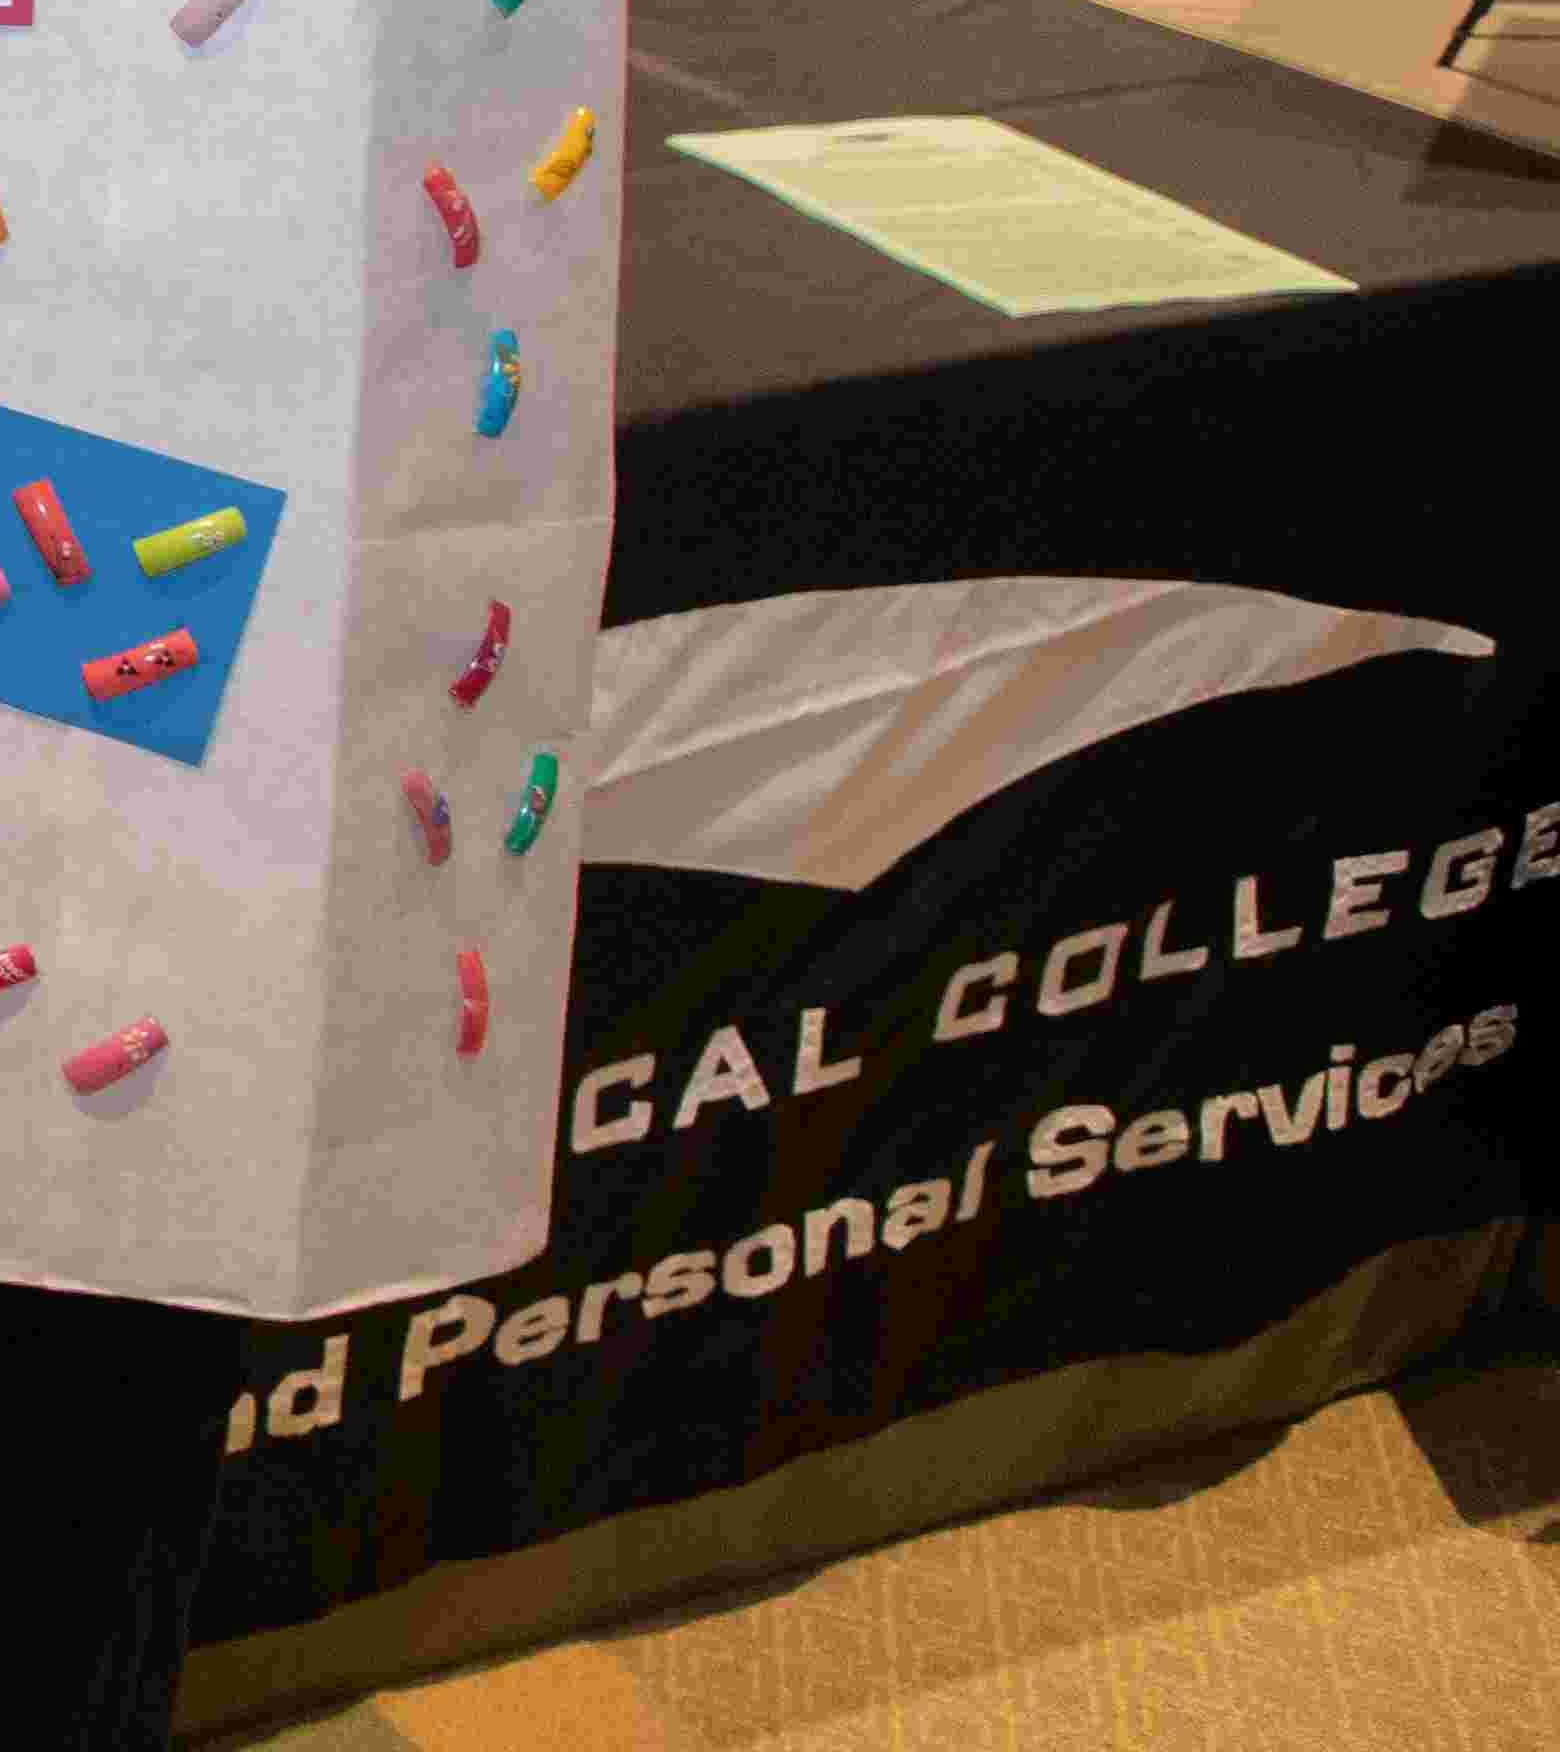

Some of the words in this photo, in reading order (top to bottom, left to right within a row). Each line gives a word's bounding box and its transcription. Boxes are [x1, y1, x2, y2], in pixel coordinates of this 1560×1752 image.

[932, 800, 1560, 1041] COLLEGE
[398, 1143, 996, 1402] Personal
[1026, 1002, 1518, 1198] Services
